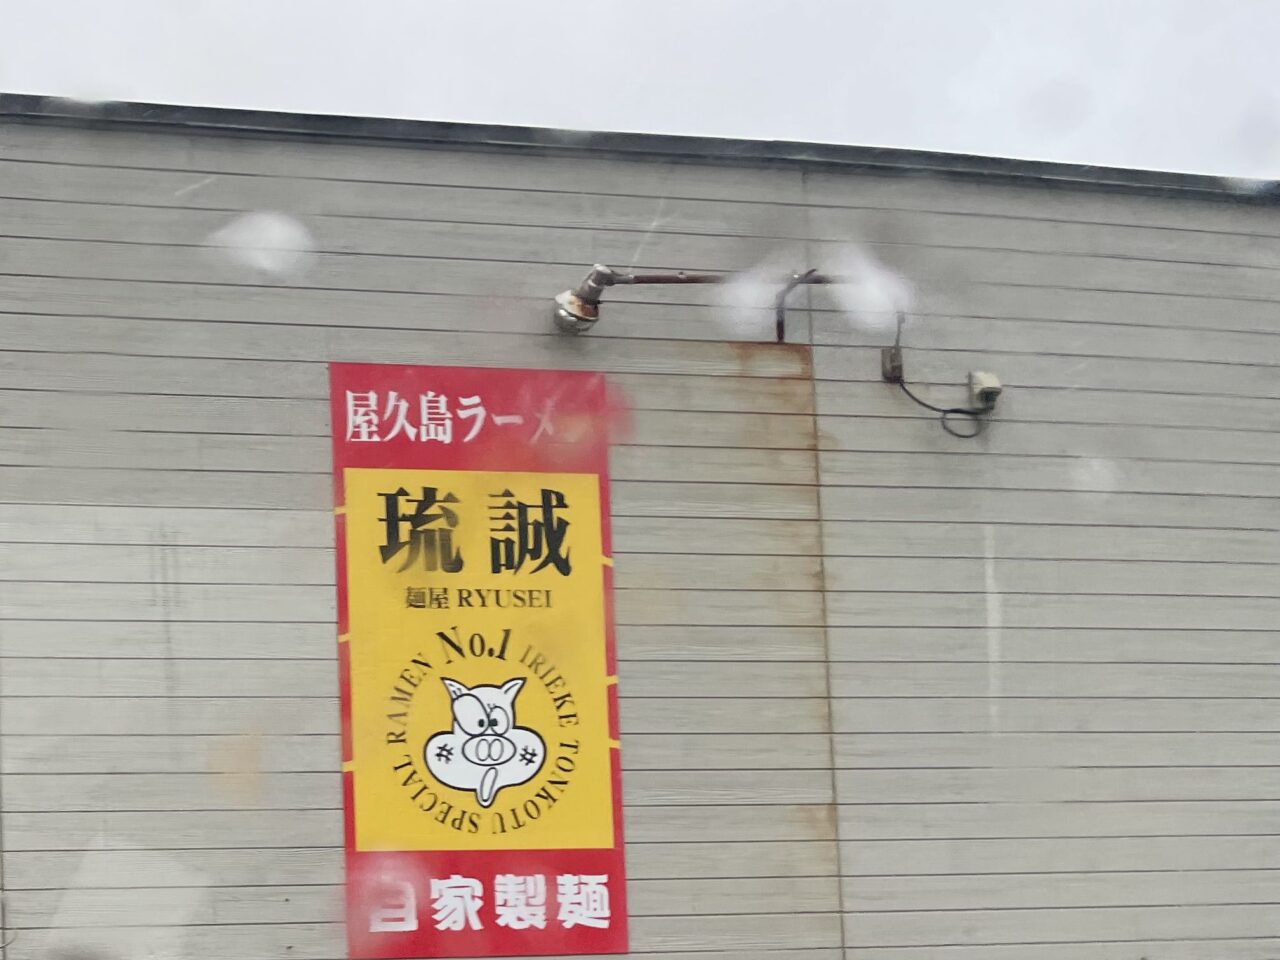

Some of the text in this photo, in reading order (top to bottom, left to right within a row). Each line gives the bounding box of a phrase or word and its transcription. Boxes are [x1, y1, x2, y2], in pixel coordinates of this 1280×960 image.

[345, 389, 592, 445] 屋久島ラーメ
[457, 588, 553, 609] RYUSEI
[436, 626, 513, 665] No.1
[386, 645, 580, 834] IRIEKE TONKOTU SPECIAL RAMEN
